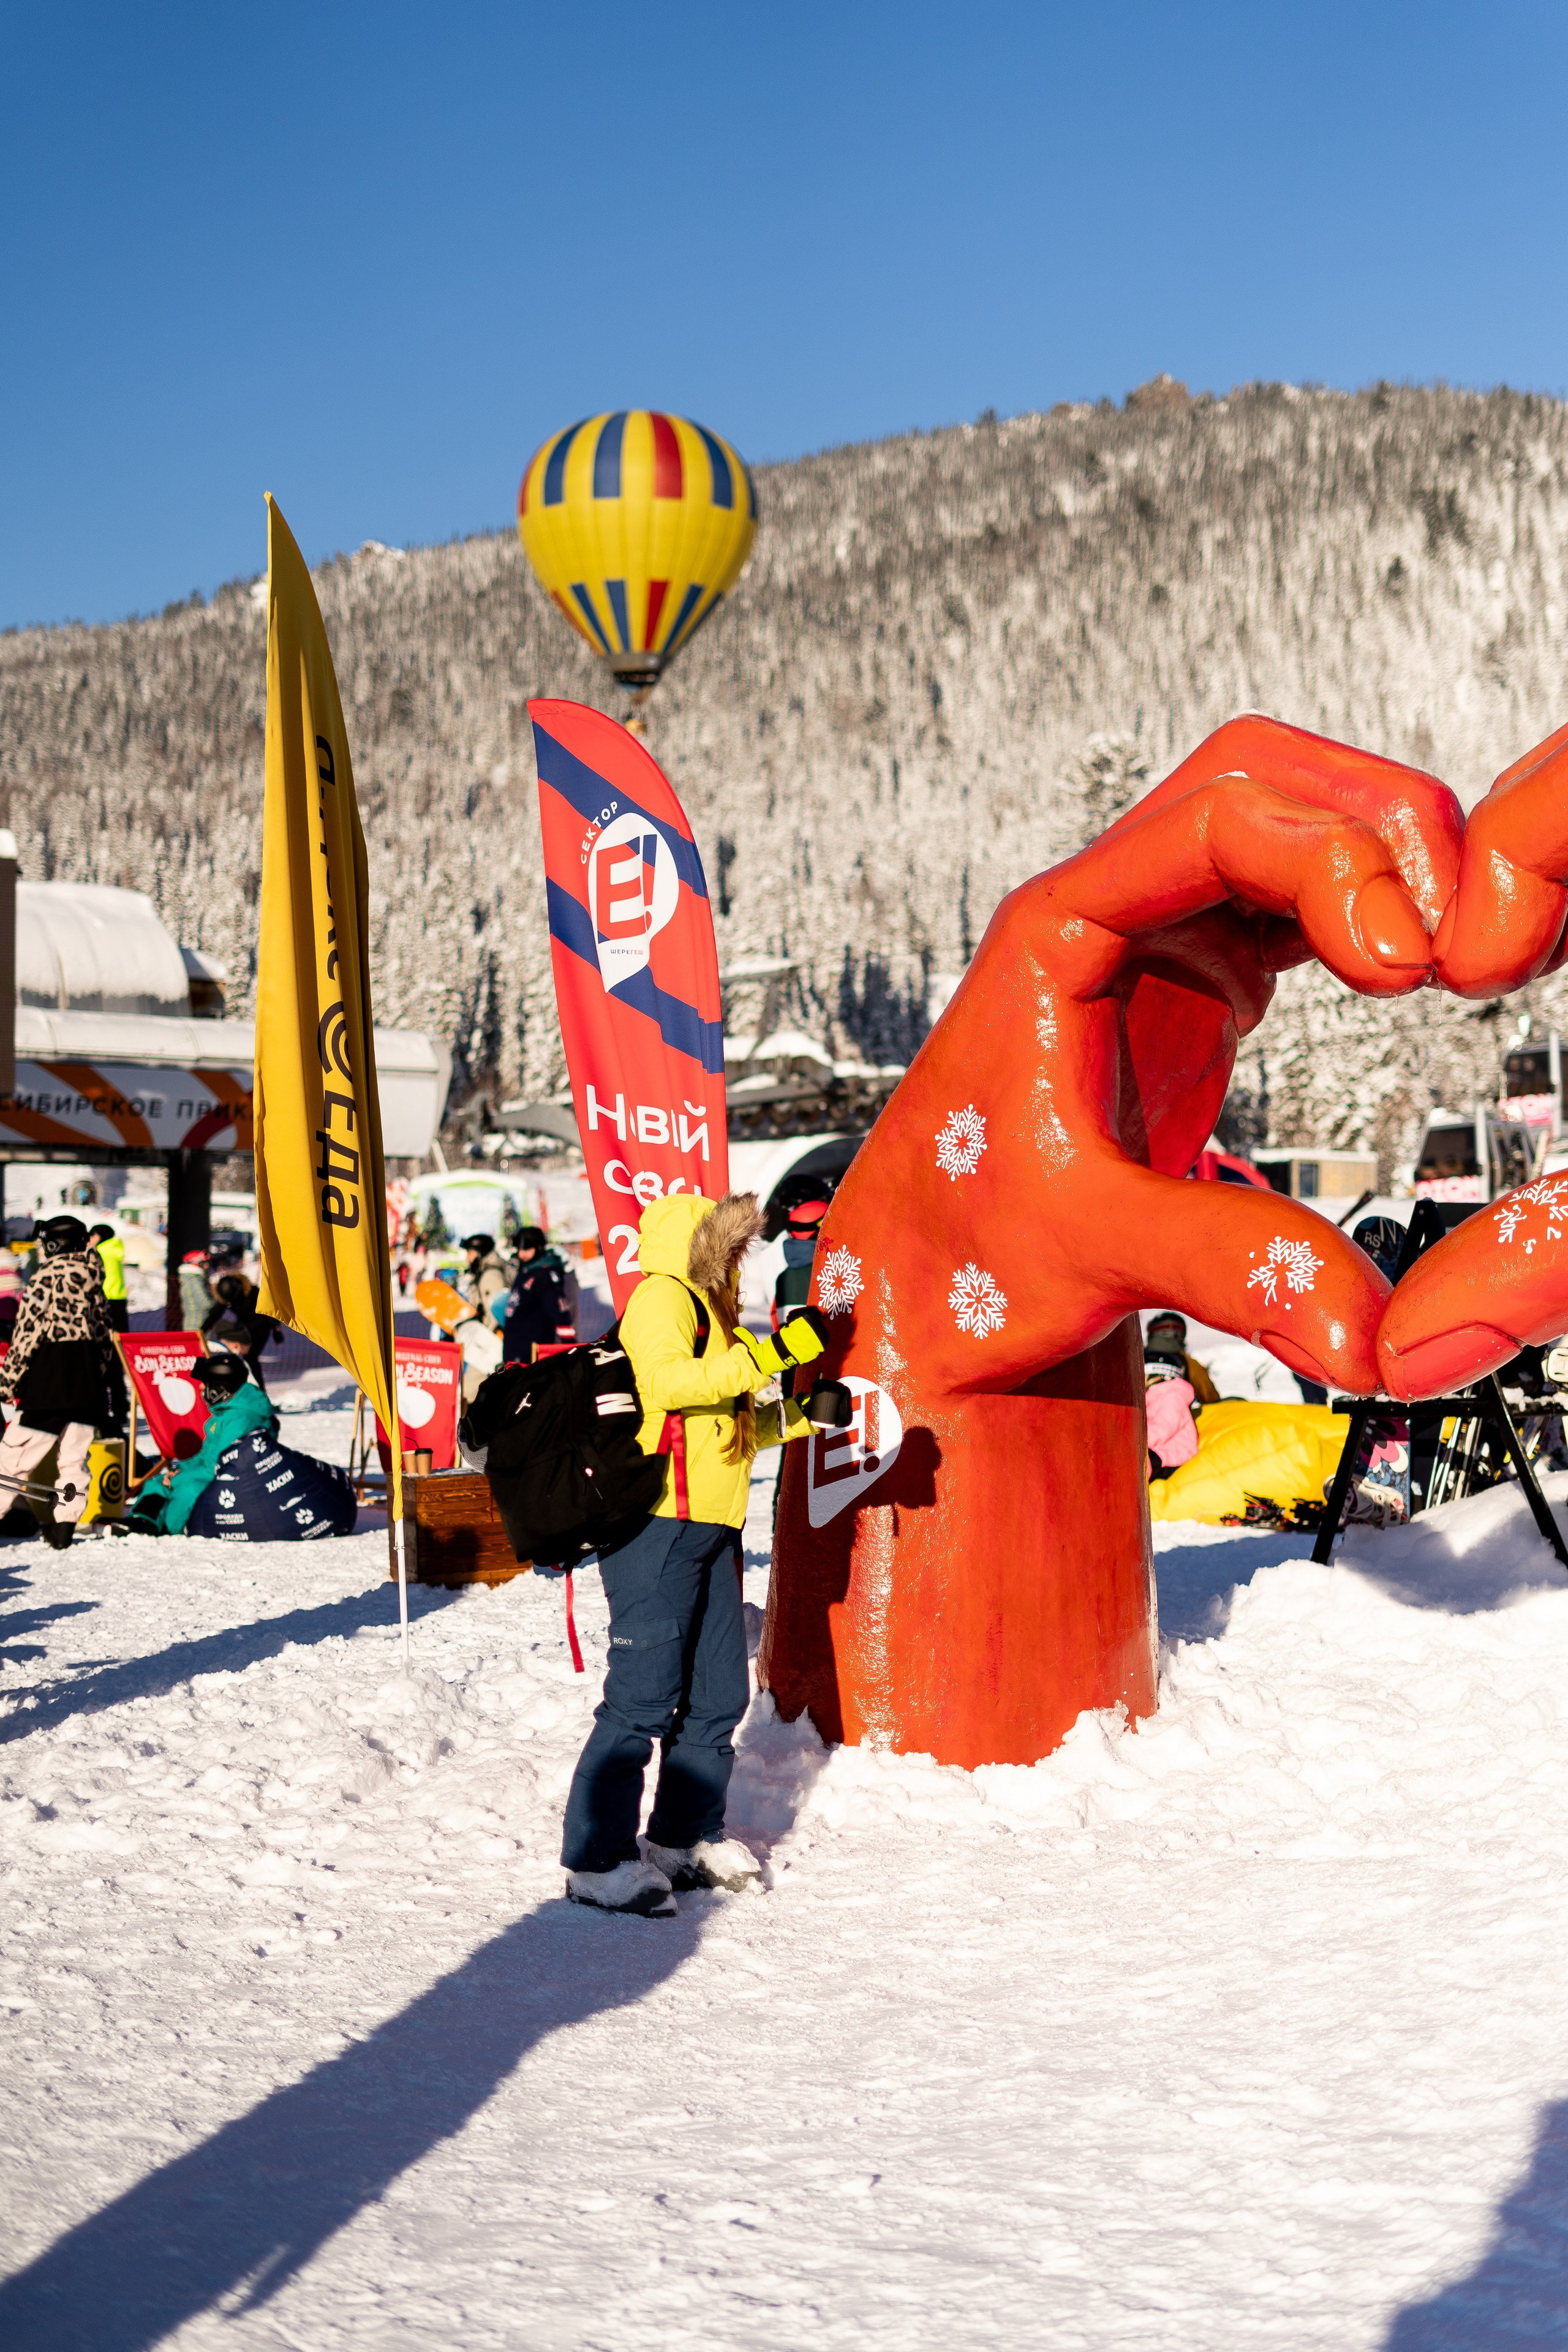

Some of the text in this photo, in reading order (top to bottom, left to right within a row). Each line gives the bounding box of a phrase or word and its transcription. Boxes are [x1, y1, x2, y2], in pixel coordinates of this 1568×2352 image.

[580, 801, 618, 865] СЕКТОР
[177, 1100, 253, 1121] ПРИК
[265, 1469, 294, 1493] ХАСКИ
